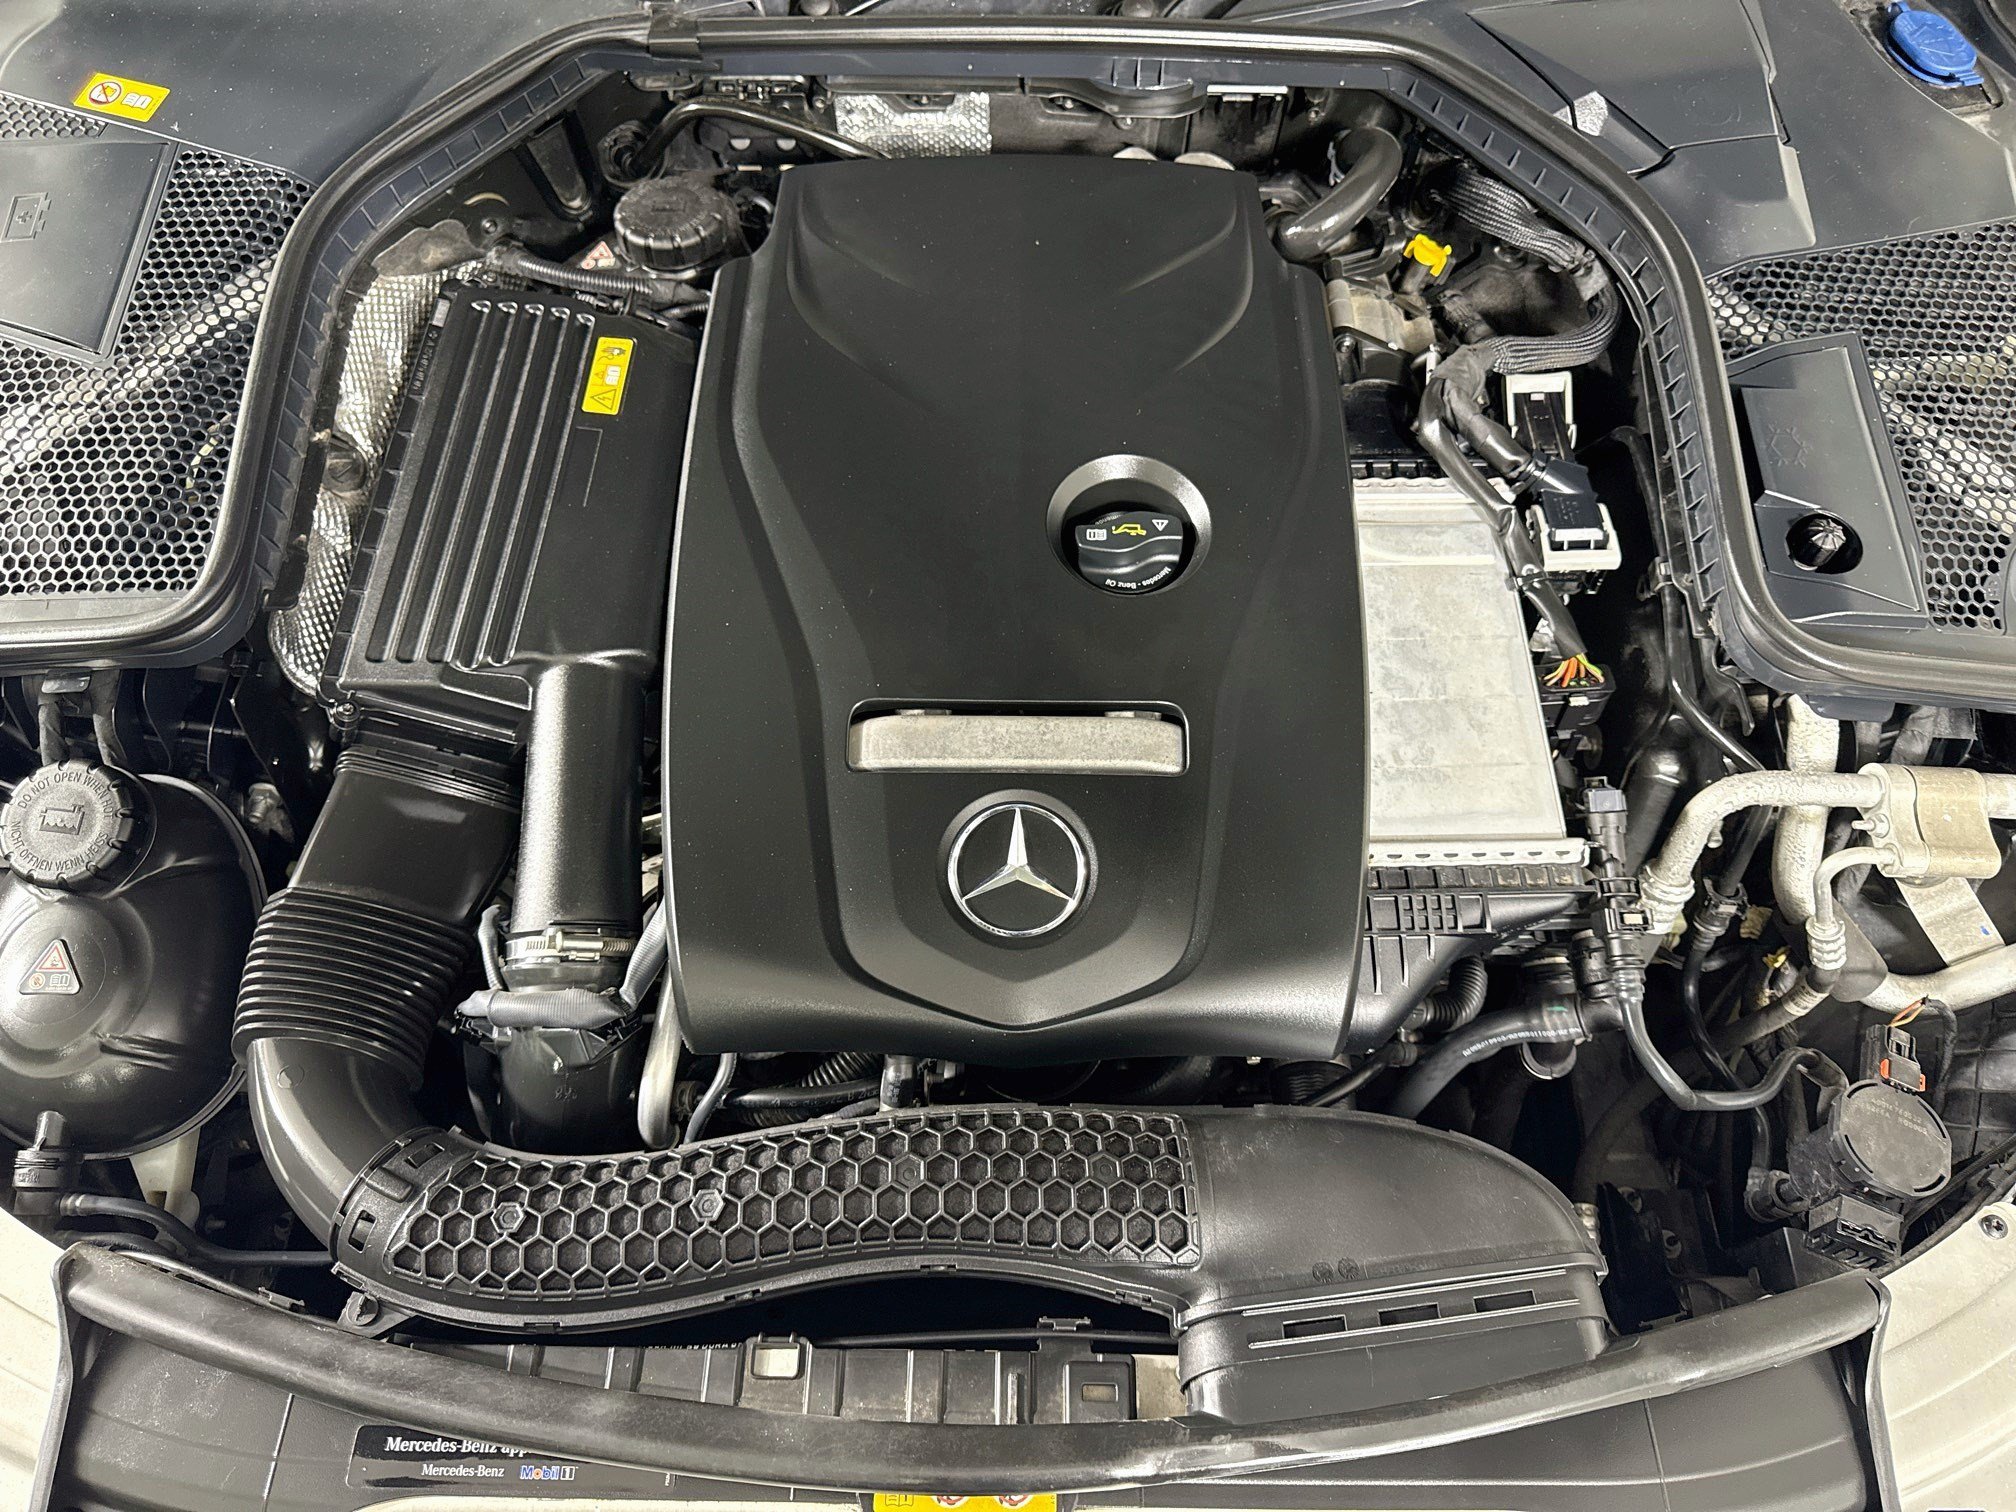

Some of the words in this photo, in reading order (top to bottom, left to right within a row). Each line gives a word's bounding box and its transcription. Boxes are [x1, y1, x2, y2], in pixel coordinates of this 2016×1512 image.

[1117, 581, 1137, 589] Benz
[18, 794, 32, 809] DO
[31, 776, 51, 796] NOT
[54, 771, 83, 783] OPEN
[82, 775, 109, 800] WHEN
[103, 800, 115, 819] HOT
[10, 820, 26, 850] NICHT
[55, 855, 84, 872] WENN
[84, 831, 109, 859] HEISS
[384, 1436, 498, 1453] Mercedes-Benz
[421, 1463, 504, 1477] Mercedes-Benz
[520, 1465, 560, 1480] Mobil
